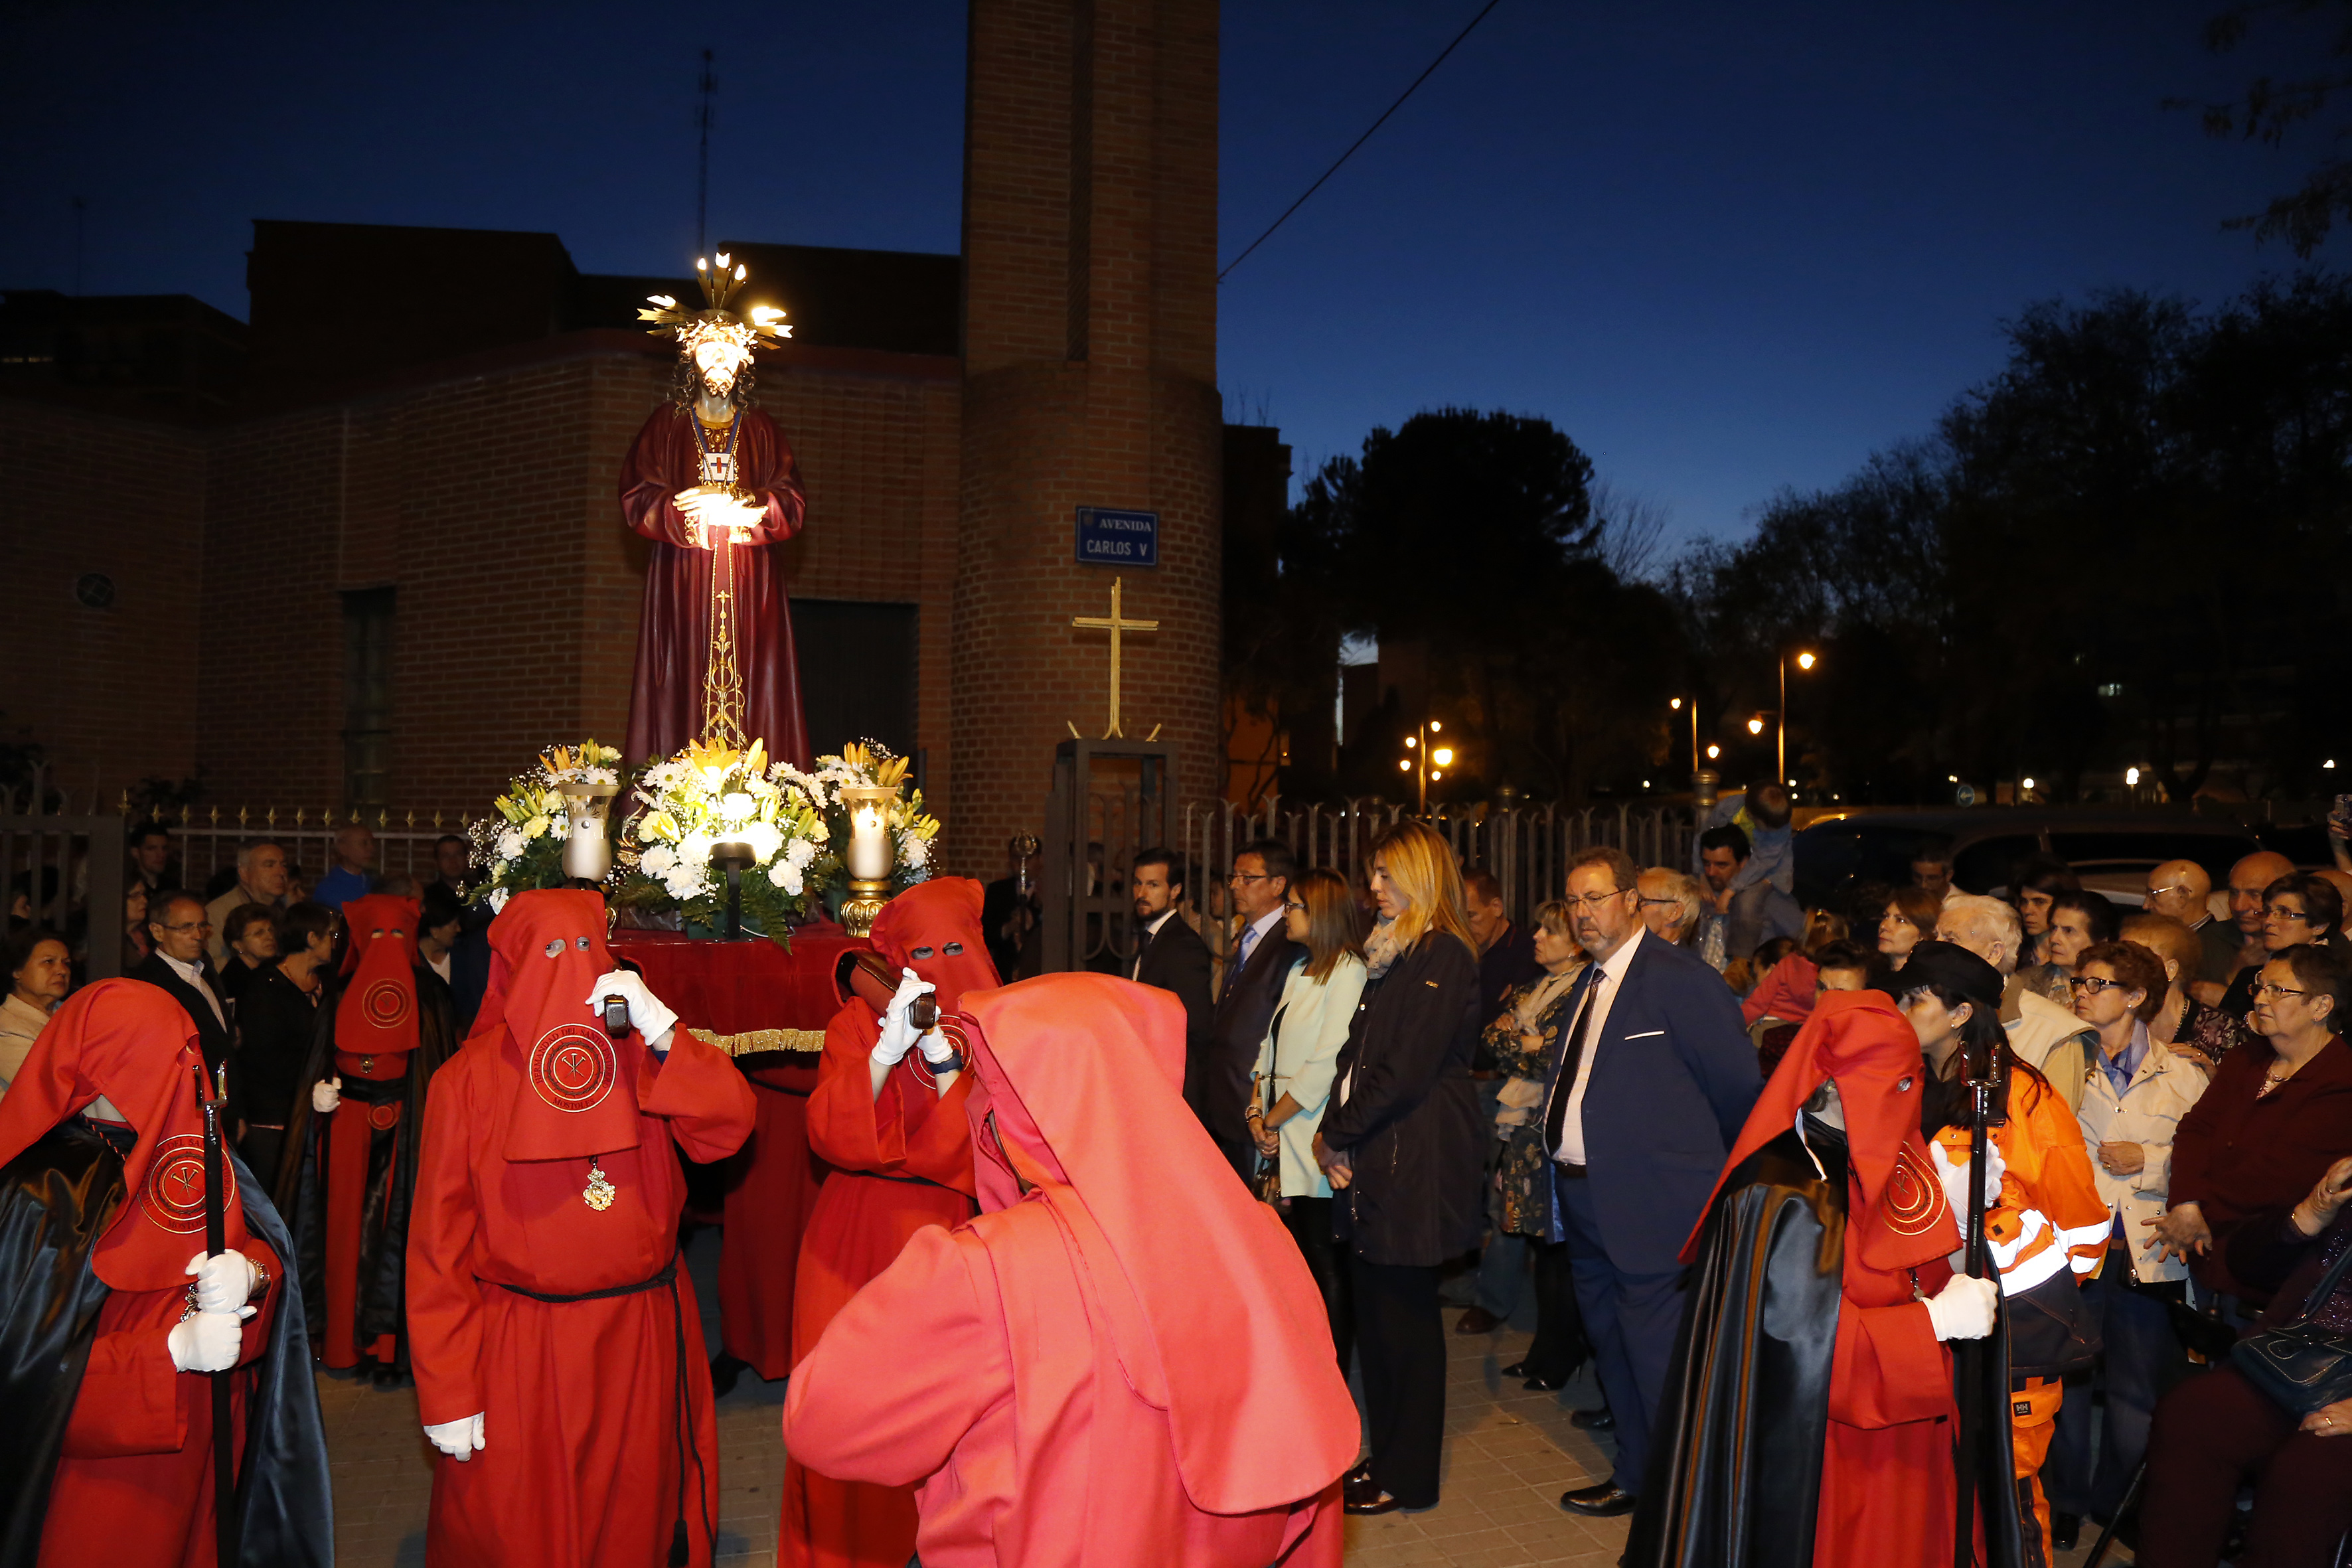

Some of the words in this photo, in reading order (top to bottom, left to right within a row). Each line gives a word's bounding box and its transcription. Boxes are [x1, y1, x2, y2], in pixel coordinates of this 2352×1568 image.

[1099, 518, 1152, 532] AVENIDA
[1087, 539, 1131, 556] CARLOS
[1139, 543, 1148, 556] V
[534, 1033, 559, 1083] HERMANDAD
[580, 1029, 605, 1047] SANTO
[553, 1097, 596, 1109] MOSTOLES
[168, 1138, 185, 1149] DEL
[169, 1219, 203, 1229] MOSTOL
